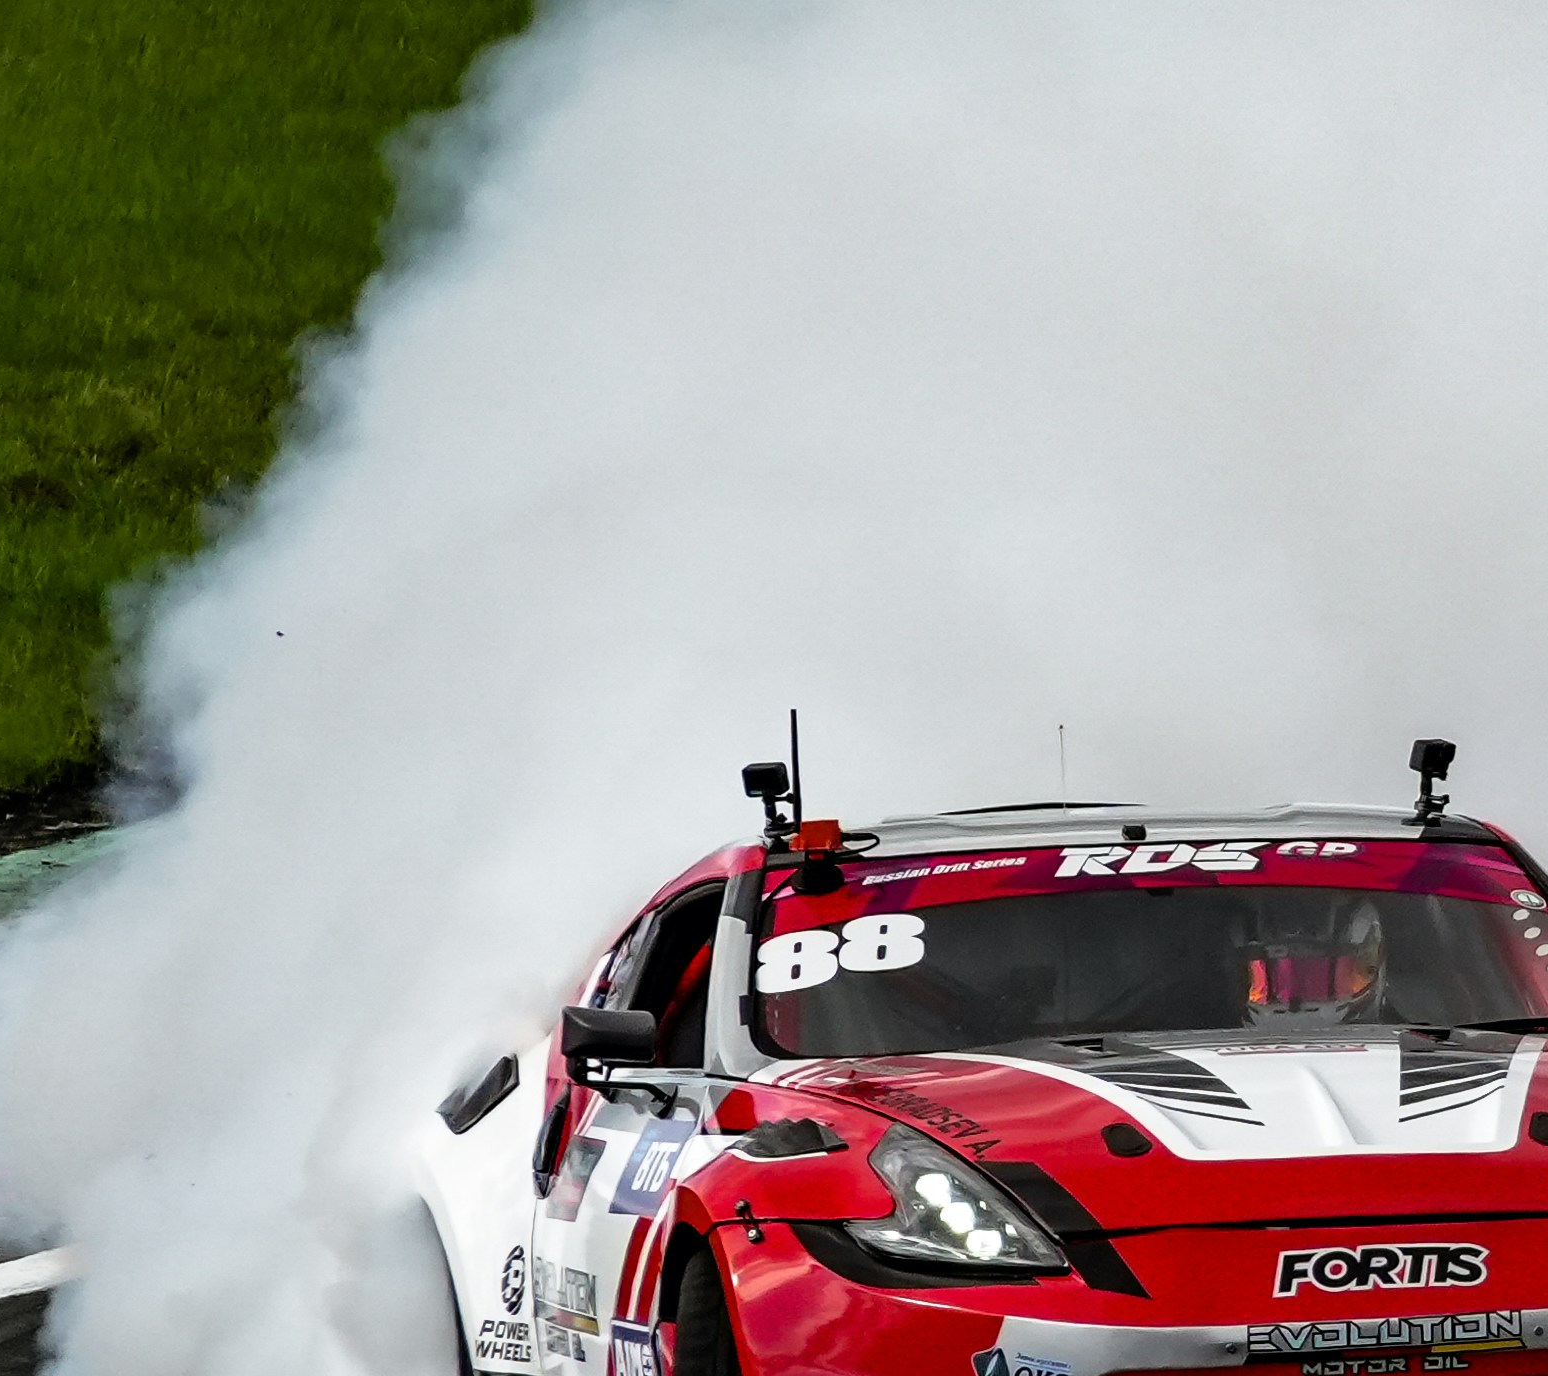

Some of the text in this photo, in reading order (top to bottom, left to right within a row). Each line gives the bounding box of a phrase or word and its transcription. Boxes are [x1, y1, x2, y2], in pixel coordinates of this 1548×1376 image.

[862, 855, 1028, 886] Russian Drift Series
[1054, 842, 1272, 878] RDS
[755, 913, 925, 994] 88
[1272, 1242, 1490, 1299] FORTIS
[479, 1319, 529, 1340] POWER
[1248, 1310, 1523, 1354] EVOLUTION
[475, 1339, 532, 1363] WHEELS
[1302, 1355, 1470, 1376] MOTOR OIL
